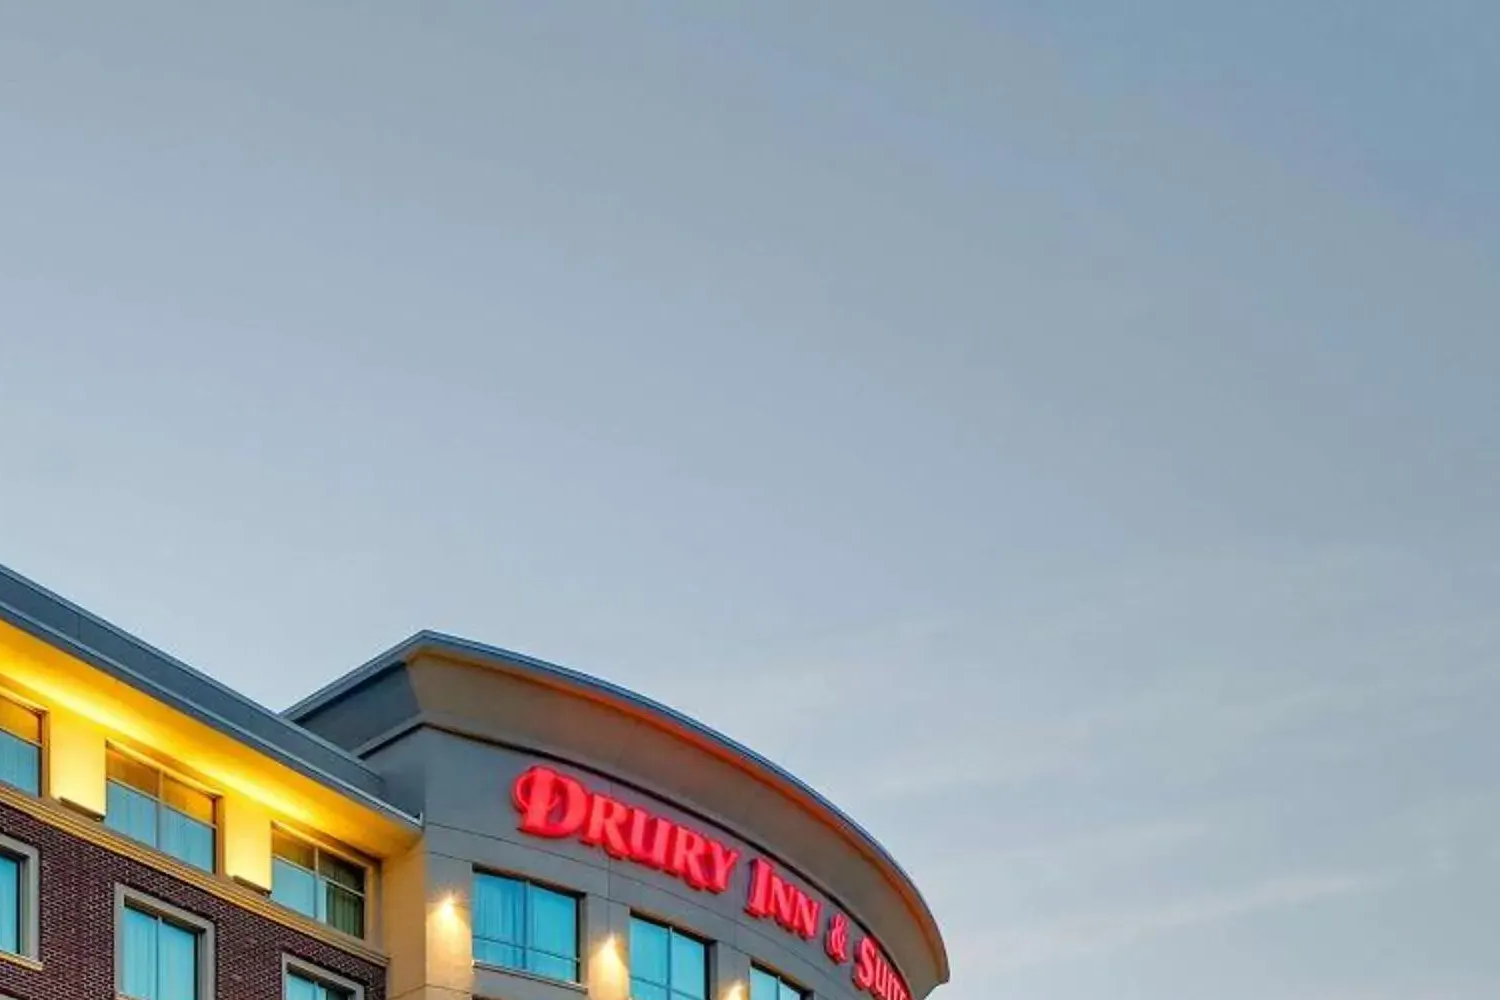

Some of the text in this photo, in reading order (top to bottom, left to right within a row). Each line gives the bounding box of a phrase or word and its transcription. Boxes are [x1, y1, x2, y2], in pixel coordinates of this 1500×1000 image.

[513, 765, 739, 895] DRURY
[745, 857, 822, 941] INN
[824, 912, 849, 965] &
